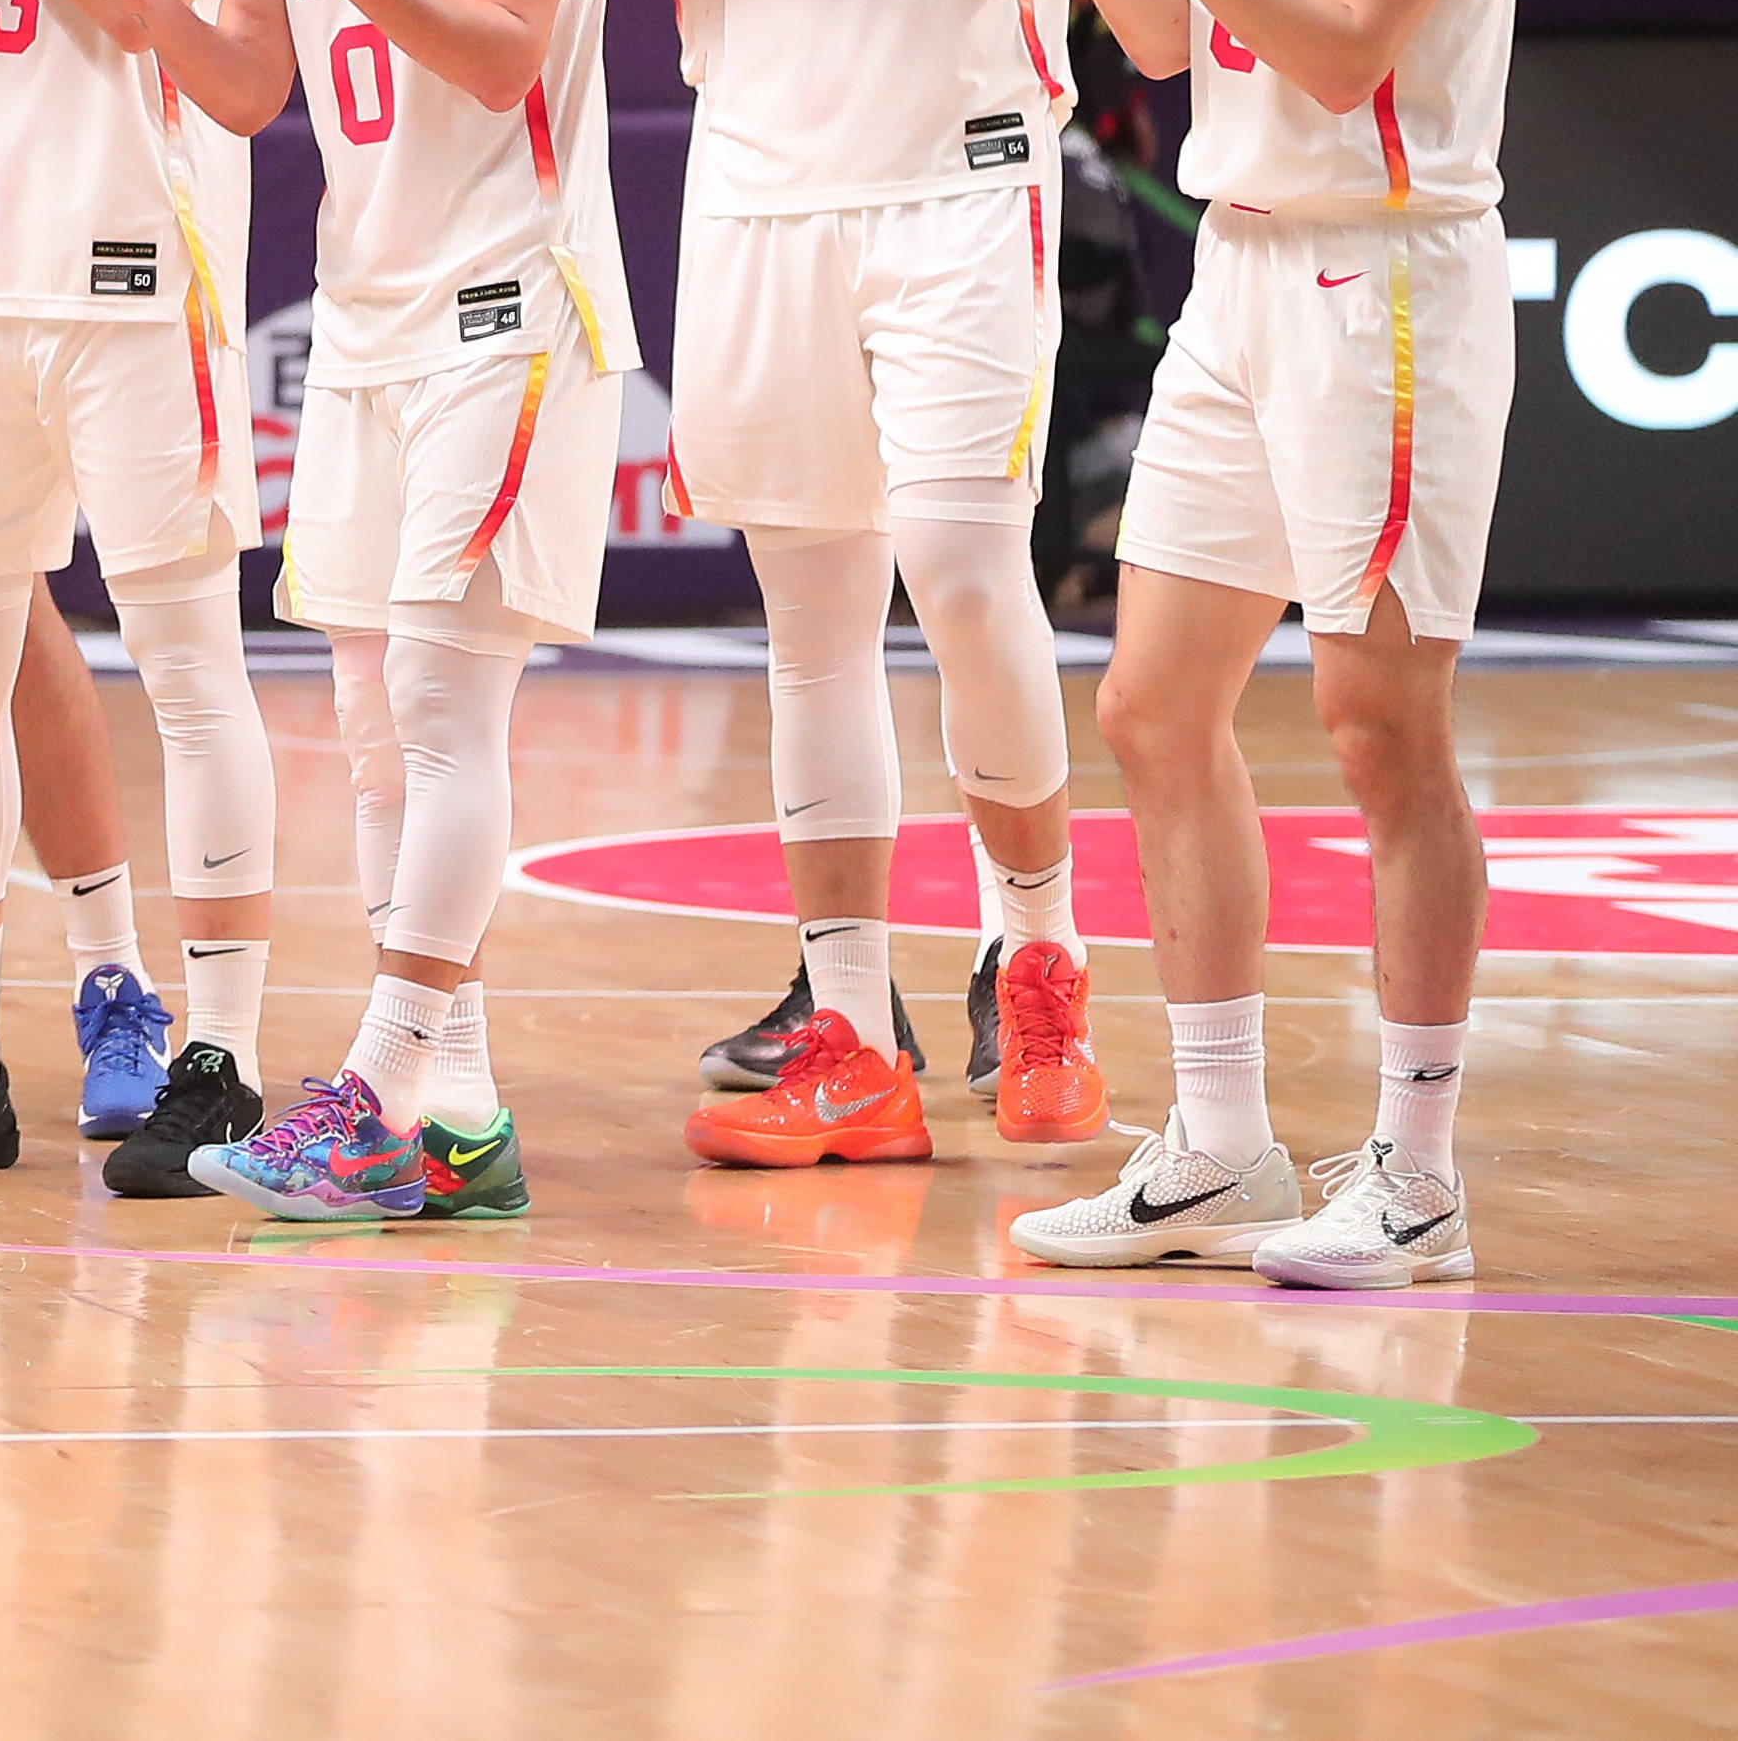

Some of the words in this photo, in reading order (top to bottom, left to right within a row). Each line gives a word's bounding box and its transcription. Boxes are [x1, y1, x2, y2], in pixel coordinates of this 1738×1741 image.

[330, 23, 395, 146] 0
[134, 273, 151, 287] 50
[500, 311, 516, 324] 48
